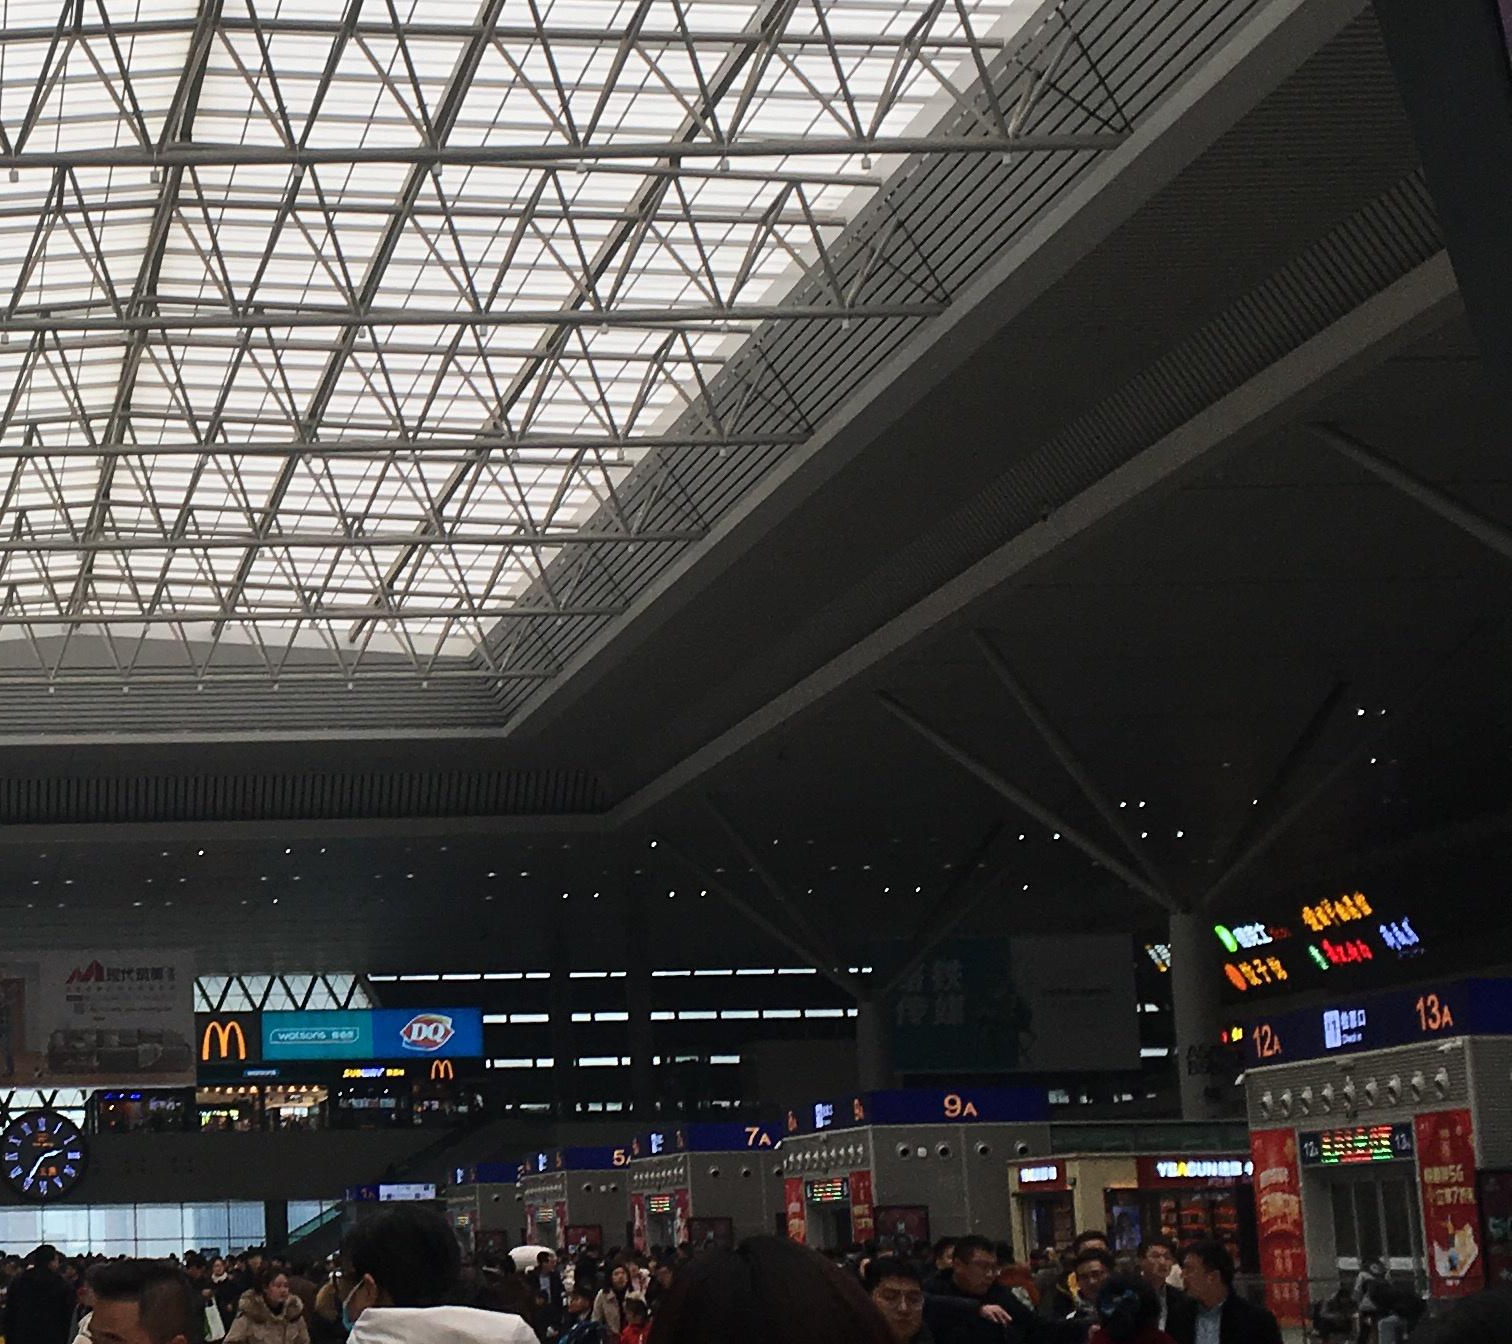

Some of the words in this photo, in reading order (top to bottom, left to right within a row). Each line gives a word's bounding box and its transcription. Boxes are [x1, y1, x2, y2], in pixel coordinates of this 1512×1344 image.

[1416, 993, 1454, 1032] 13A
[278, 1030, 327, 1041] watsons
[410, 1022, 445, 1044] DQ
[1253, 1024, 1283, 1059] 12A
[943, 1094, 979, 1119] 9A
[744, 1127, 772, 1147] 7A
